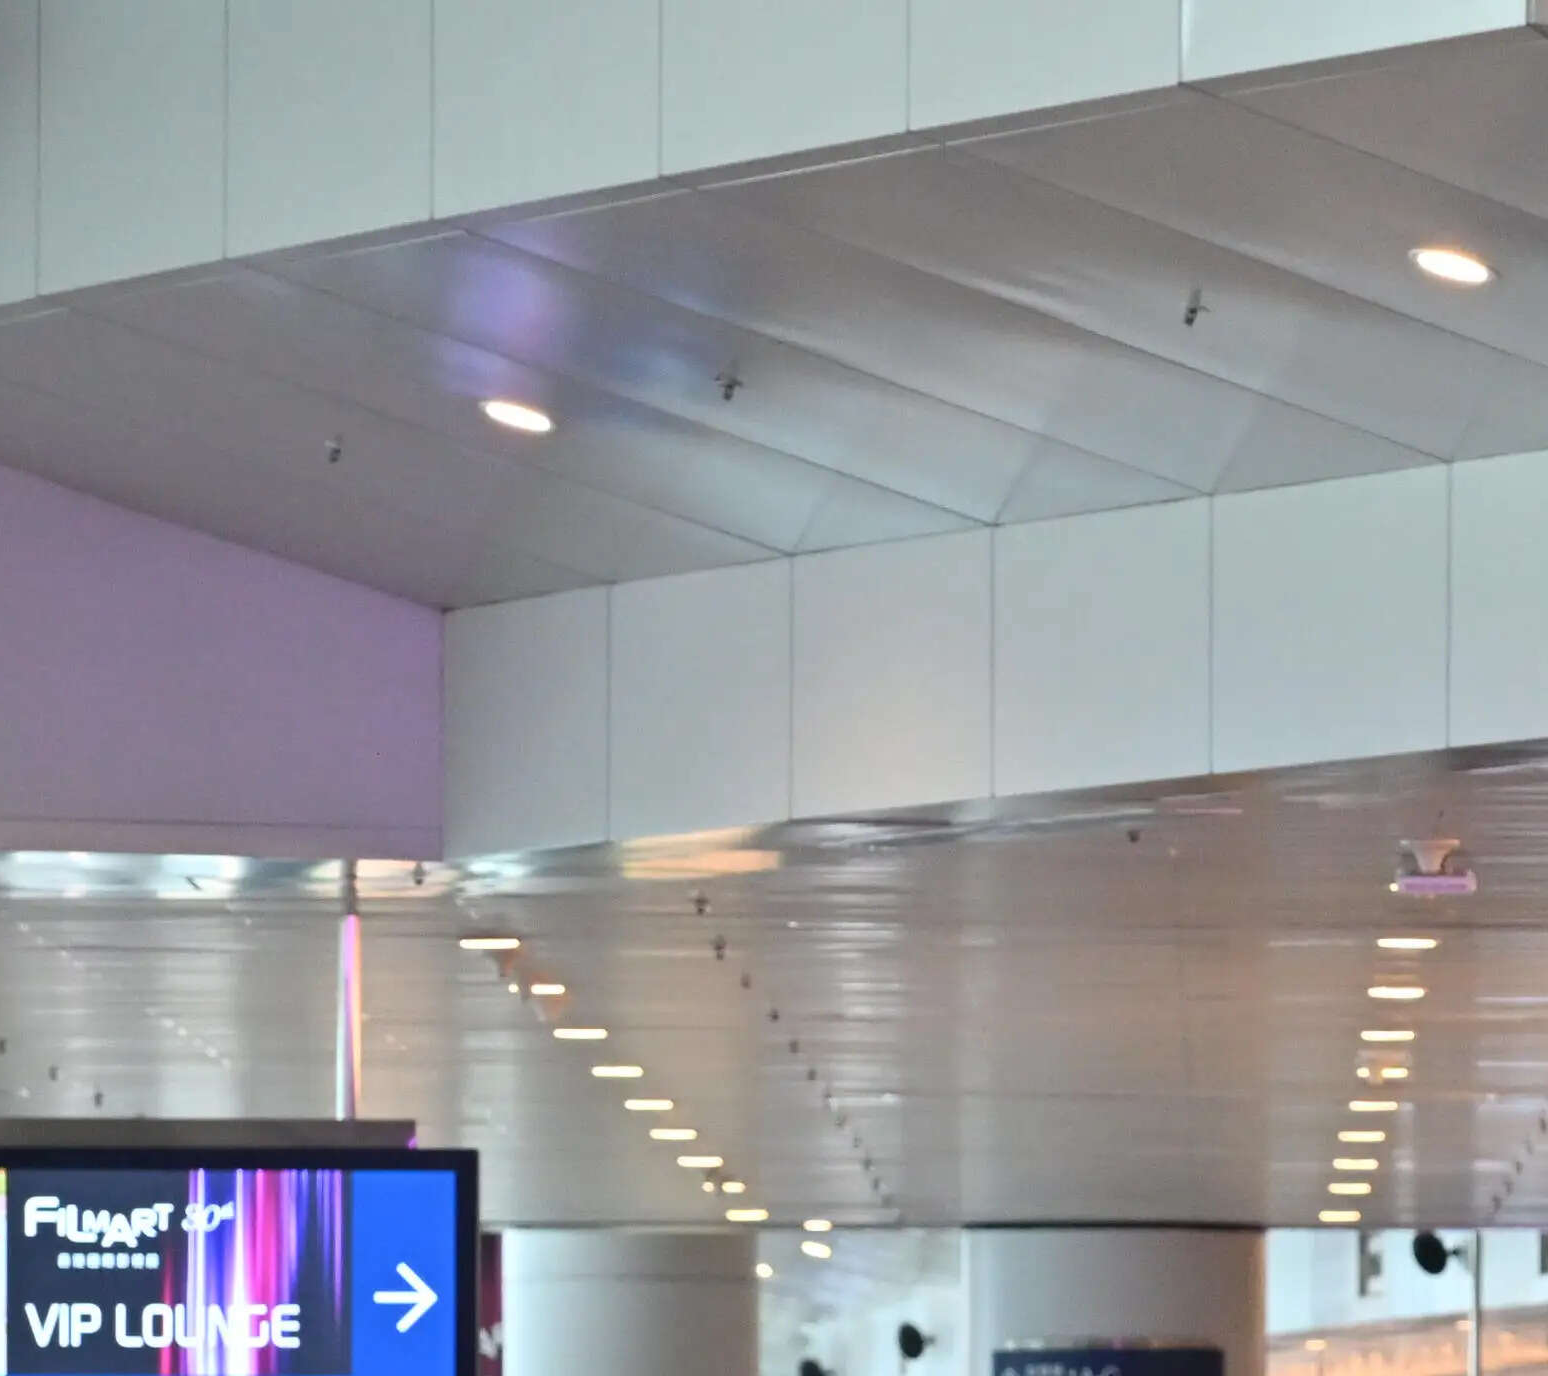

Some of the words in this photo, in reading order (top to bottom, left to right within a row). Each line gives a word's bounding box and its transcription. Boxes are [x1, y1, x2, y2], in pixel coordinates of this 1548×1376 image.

[24, 1195, 174, 1248] FILMART
[24, 1302, 103, 1349] VIP
[114, 1302, 301, 1349] LOUNGE
